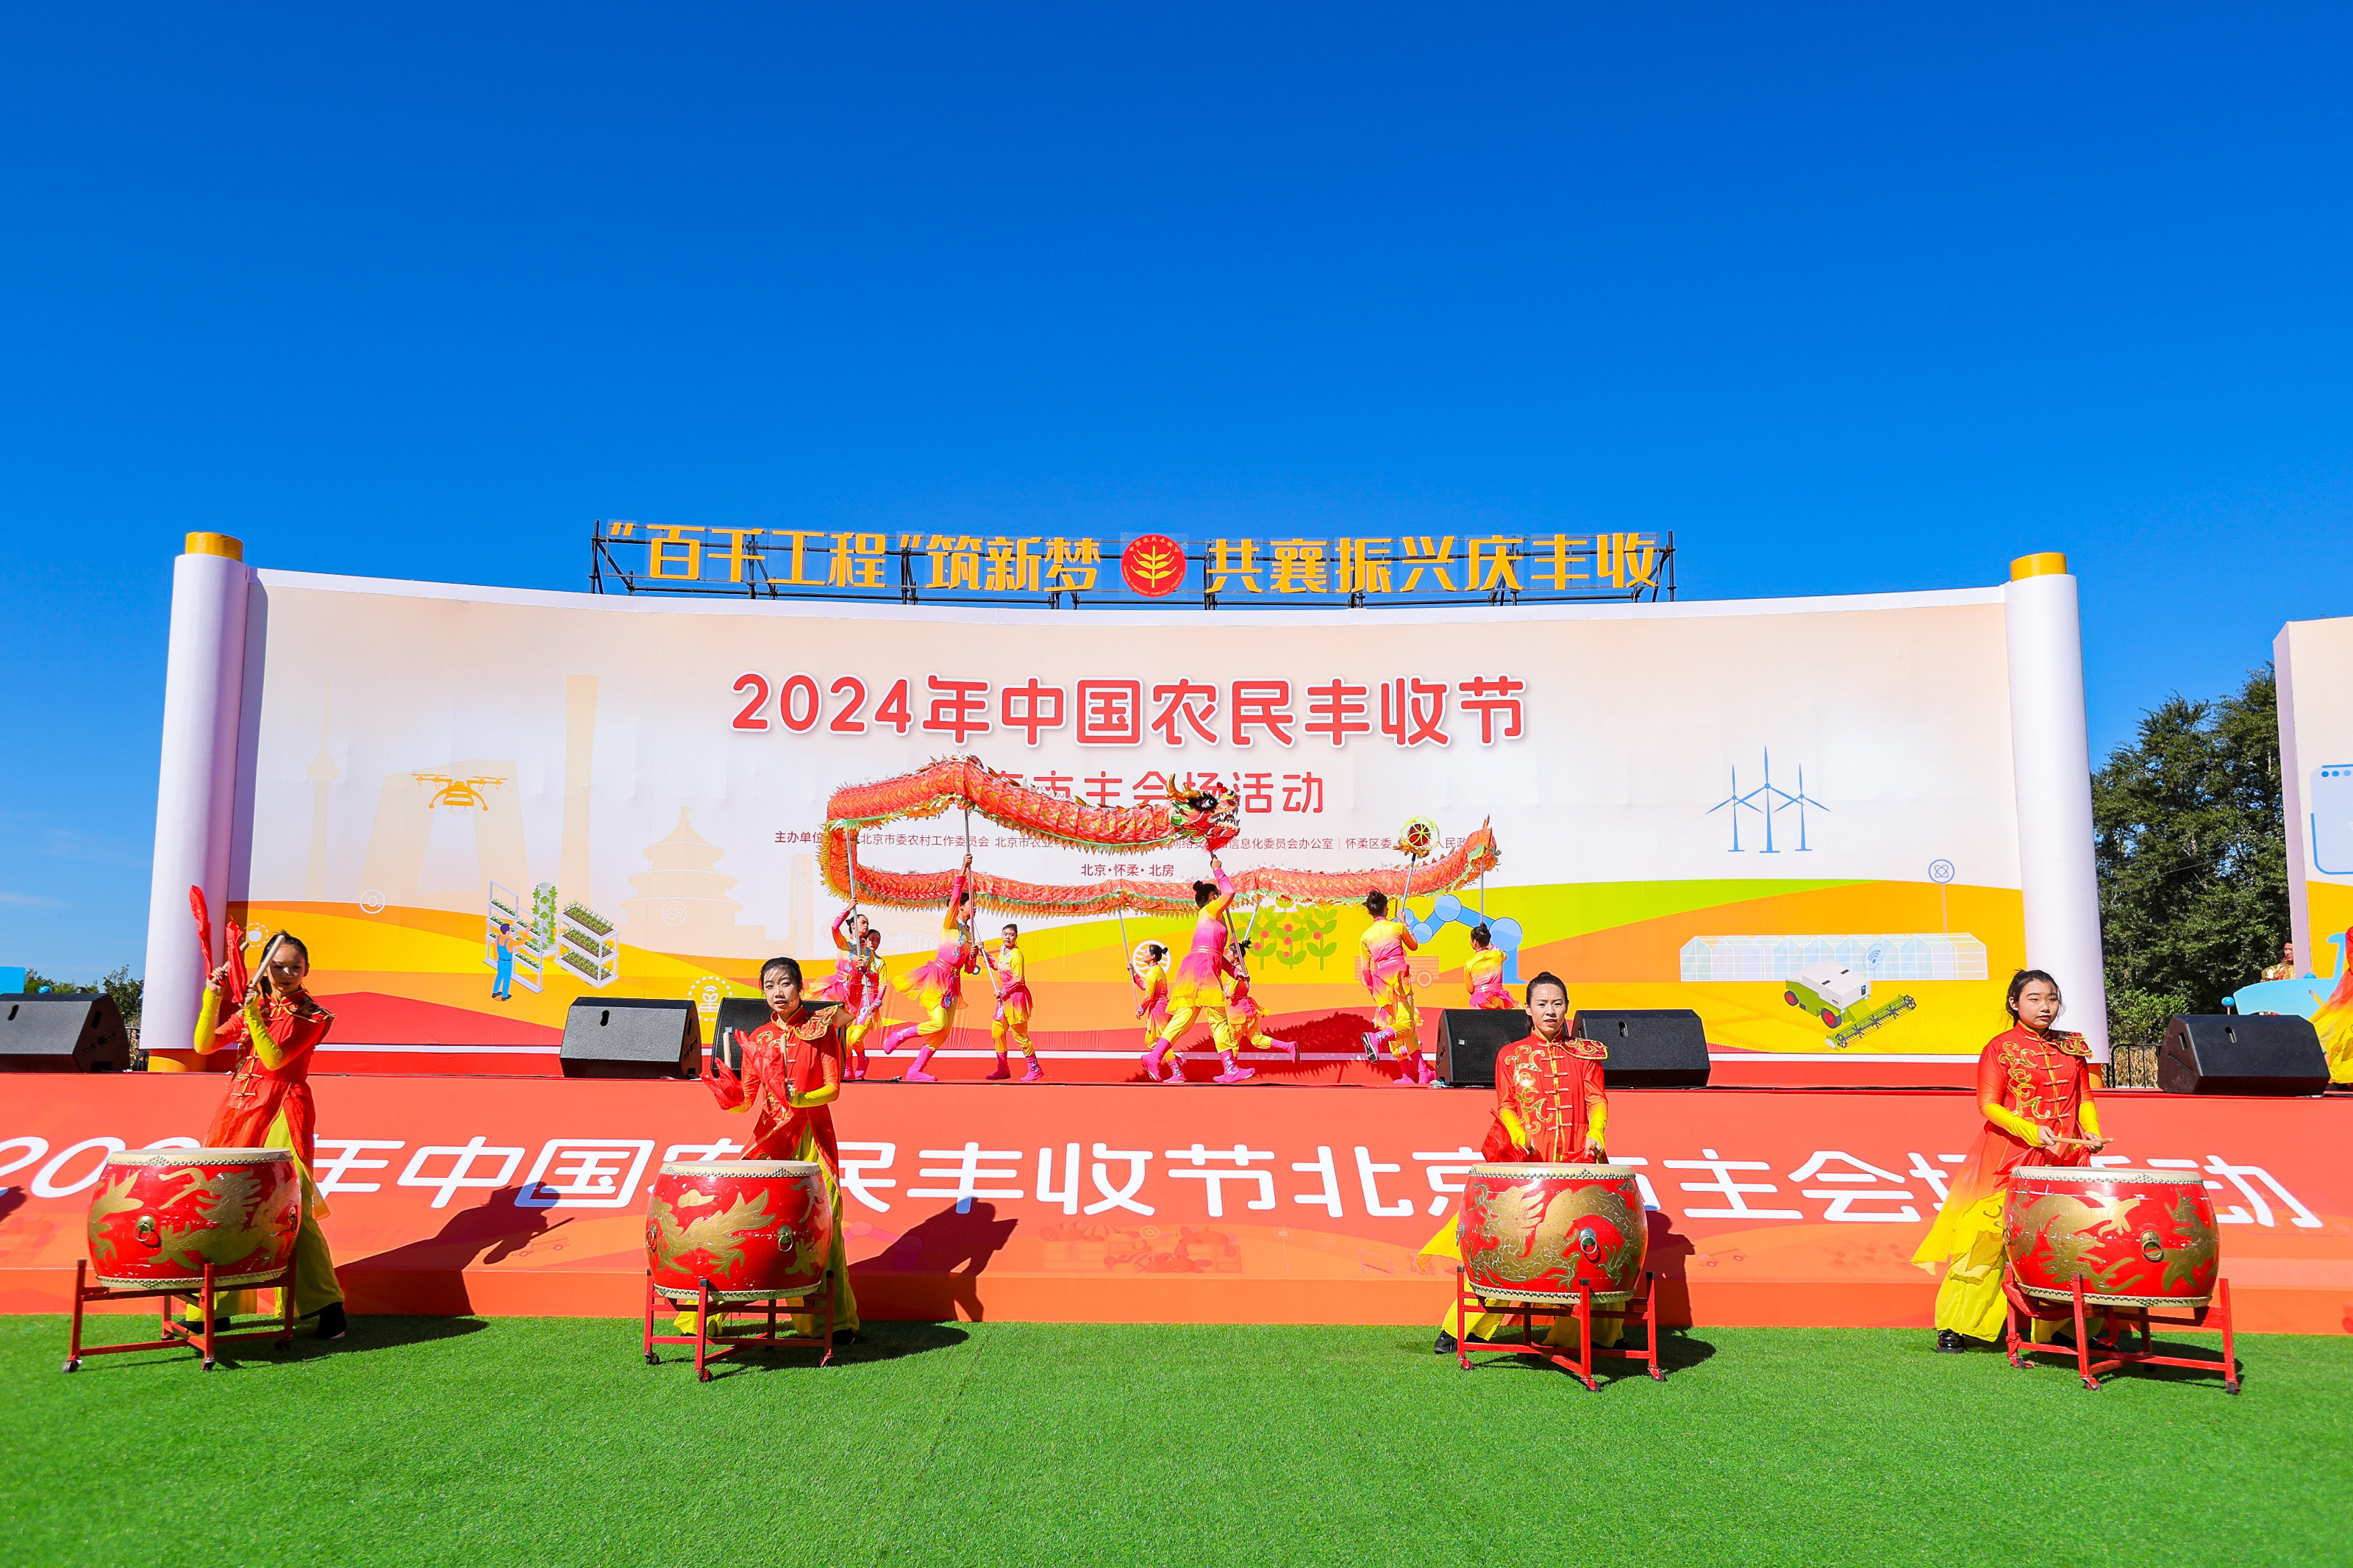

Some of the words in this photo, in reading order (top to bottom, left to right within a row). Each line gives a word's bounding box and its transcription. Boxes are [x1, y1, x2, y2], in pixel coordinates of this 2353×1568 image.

[1206, 532, 1658, 594] 共襄振兴庆丰收
[732, 672, 1526, 748] 2024年中国农民丰收节
